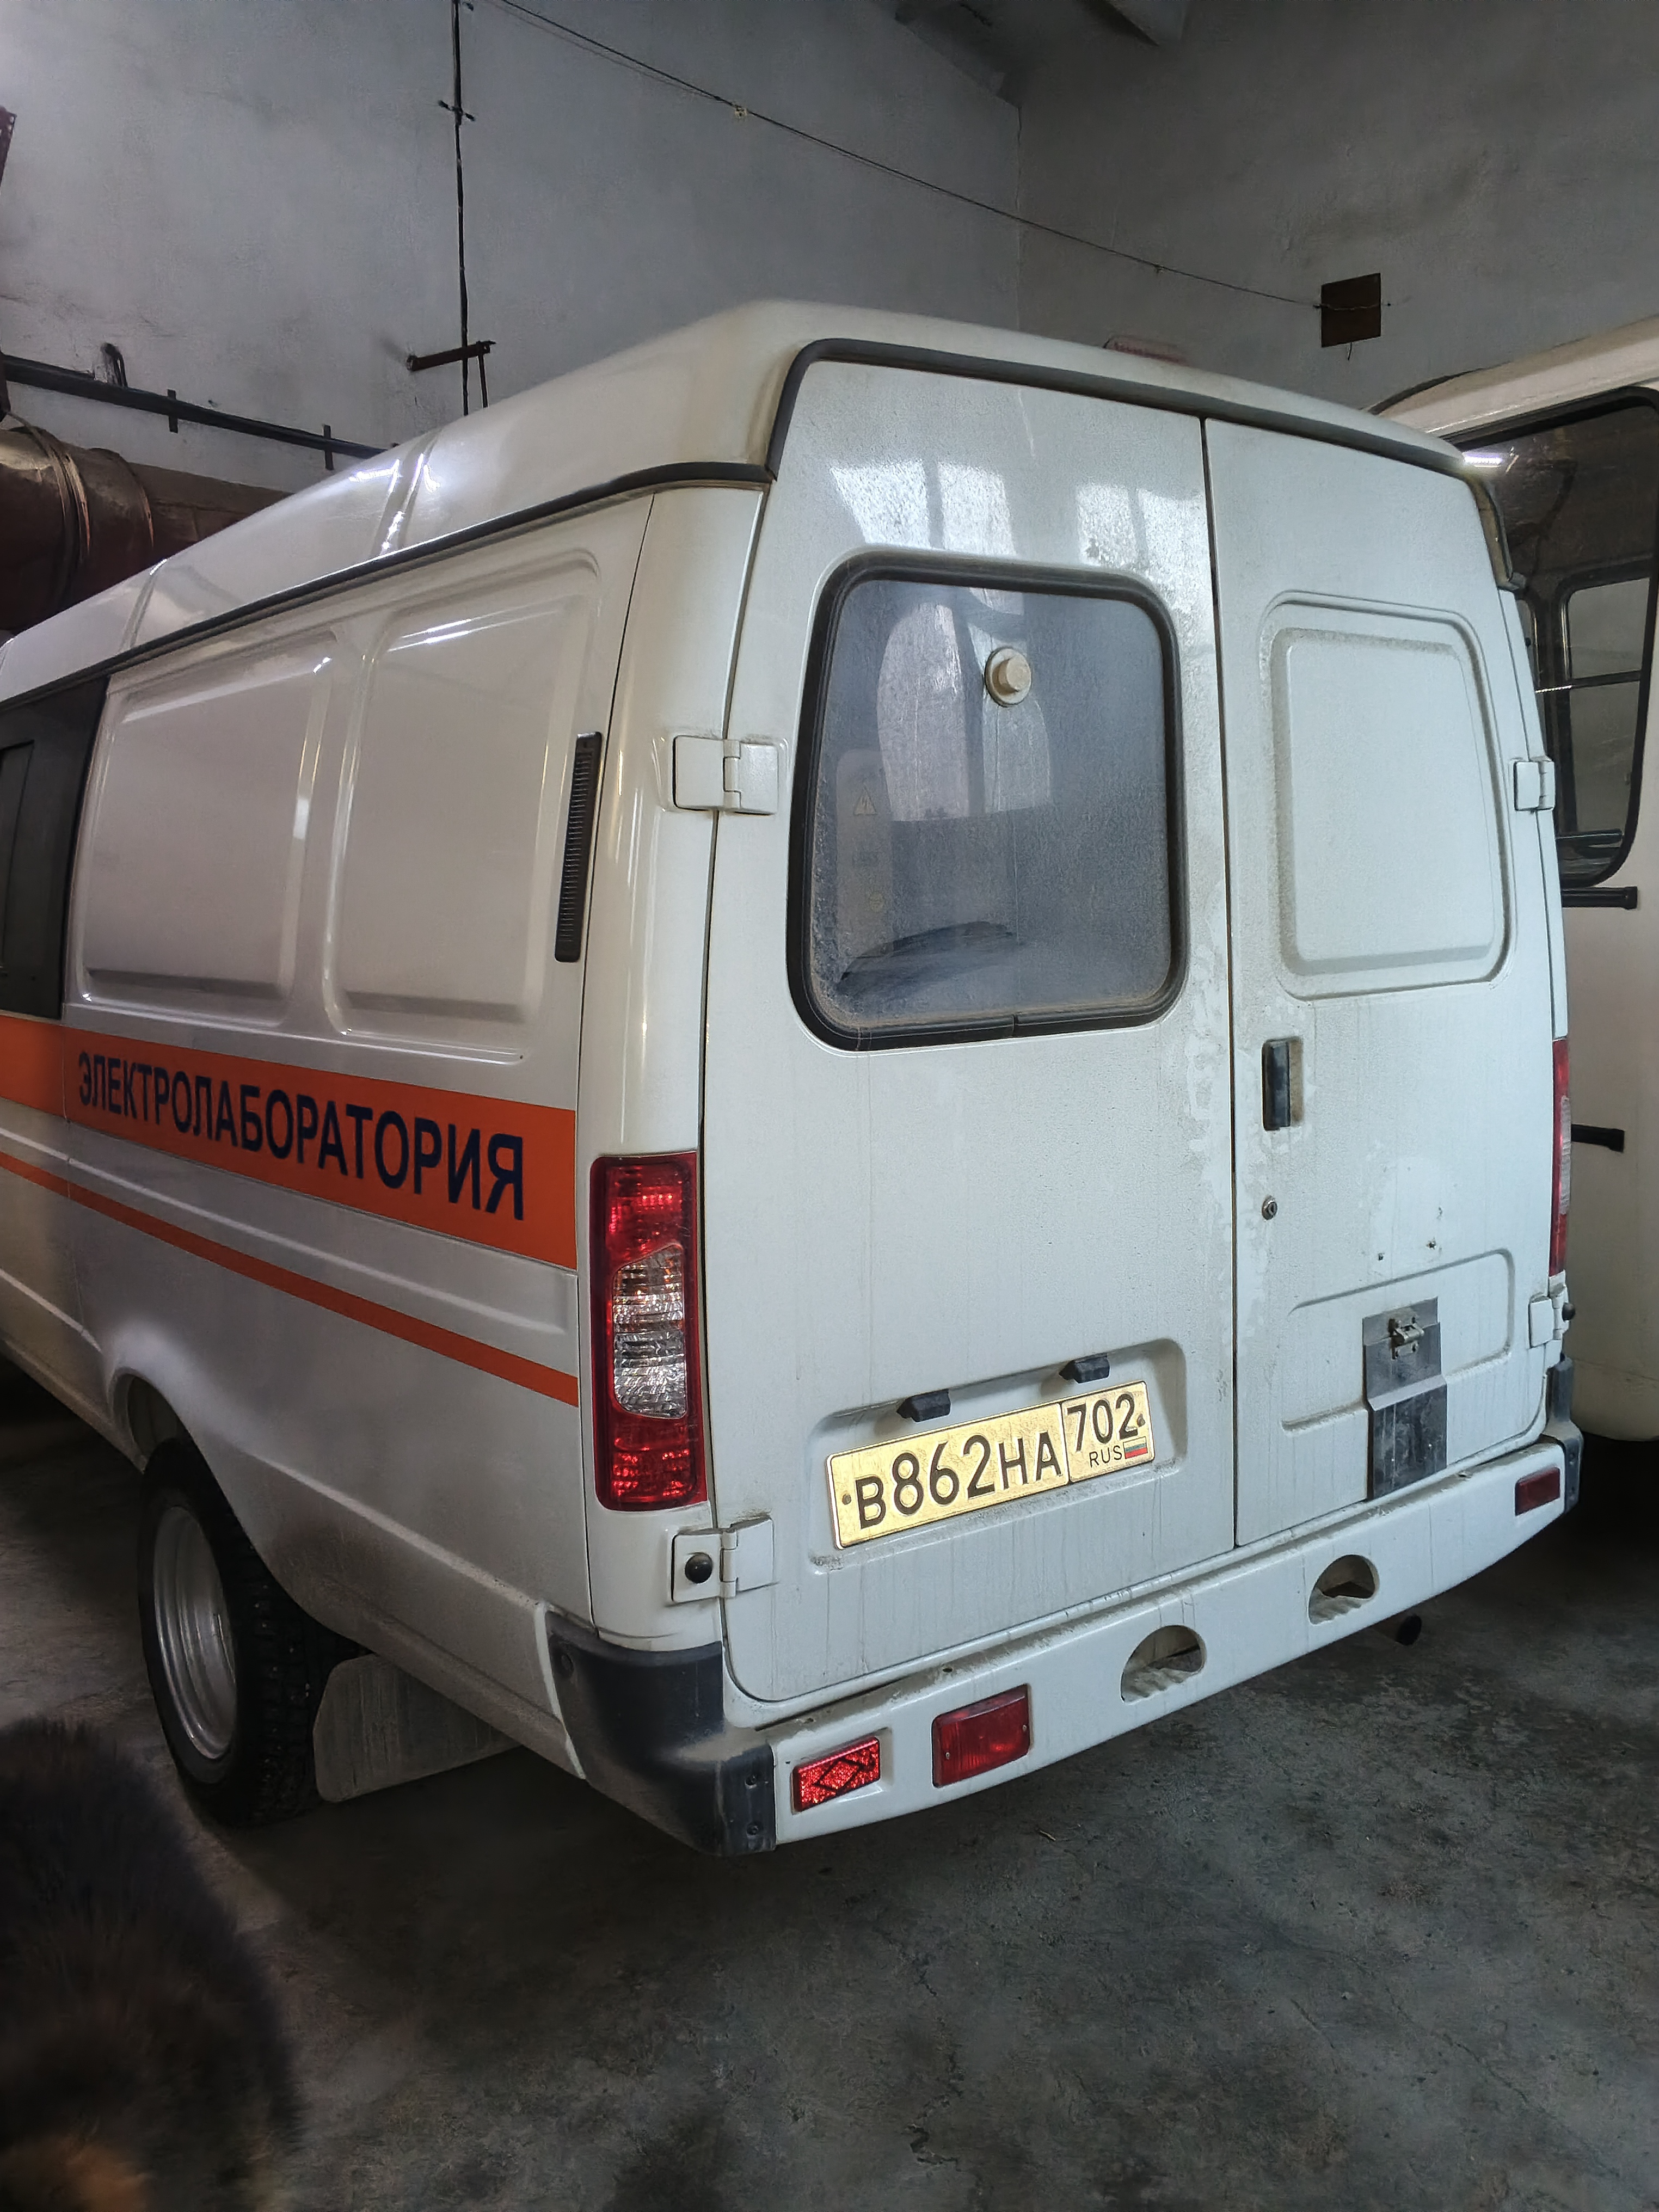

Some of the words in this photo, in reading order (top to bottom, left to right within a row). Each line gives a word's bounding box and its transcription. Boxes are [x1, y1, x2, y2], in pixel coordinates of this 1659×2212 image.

[78, 1051, 524, 1221] ЭЛЕКТРОЛАБОРАТОРИЯ
[1066, 1393, 1138, 1452] 702
[1089, 1446, 1122, 1470] RUS
